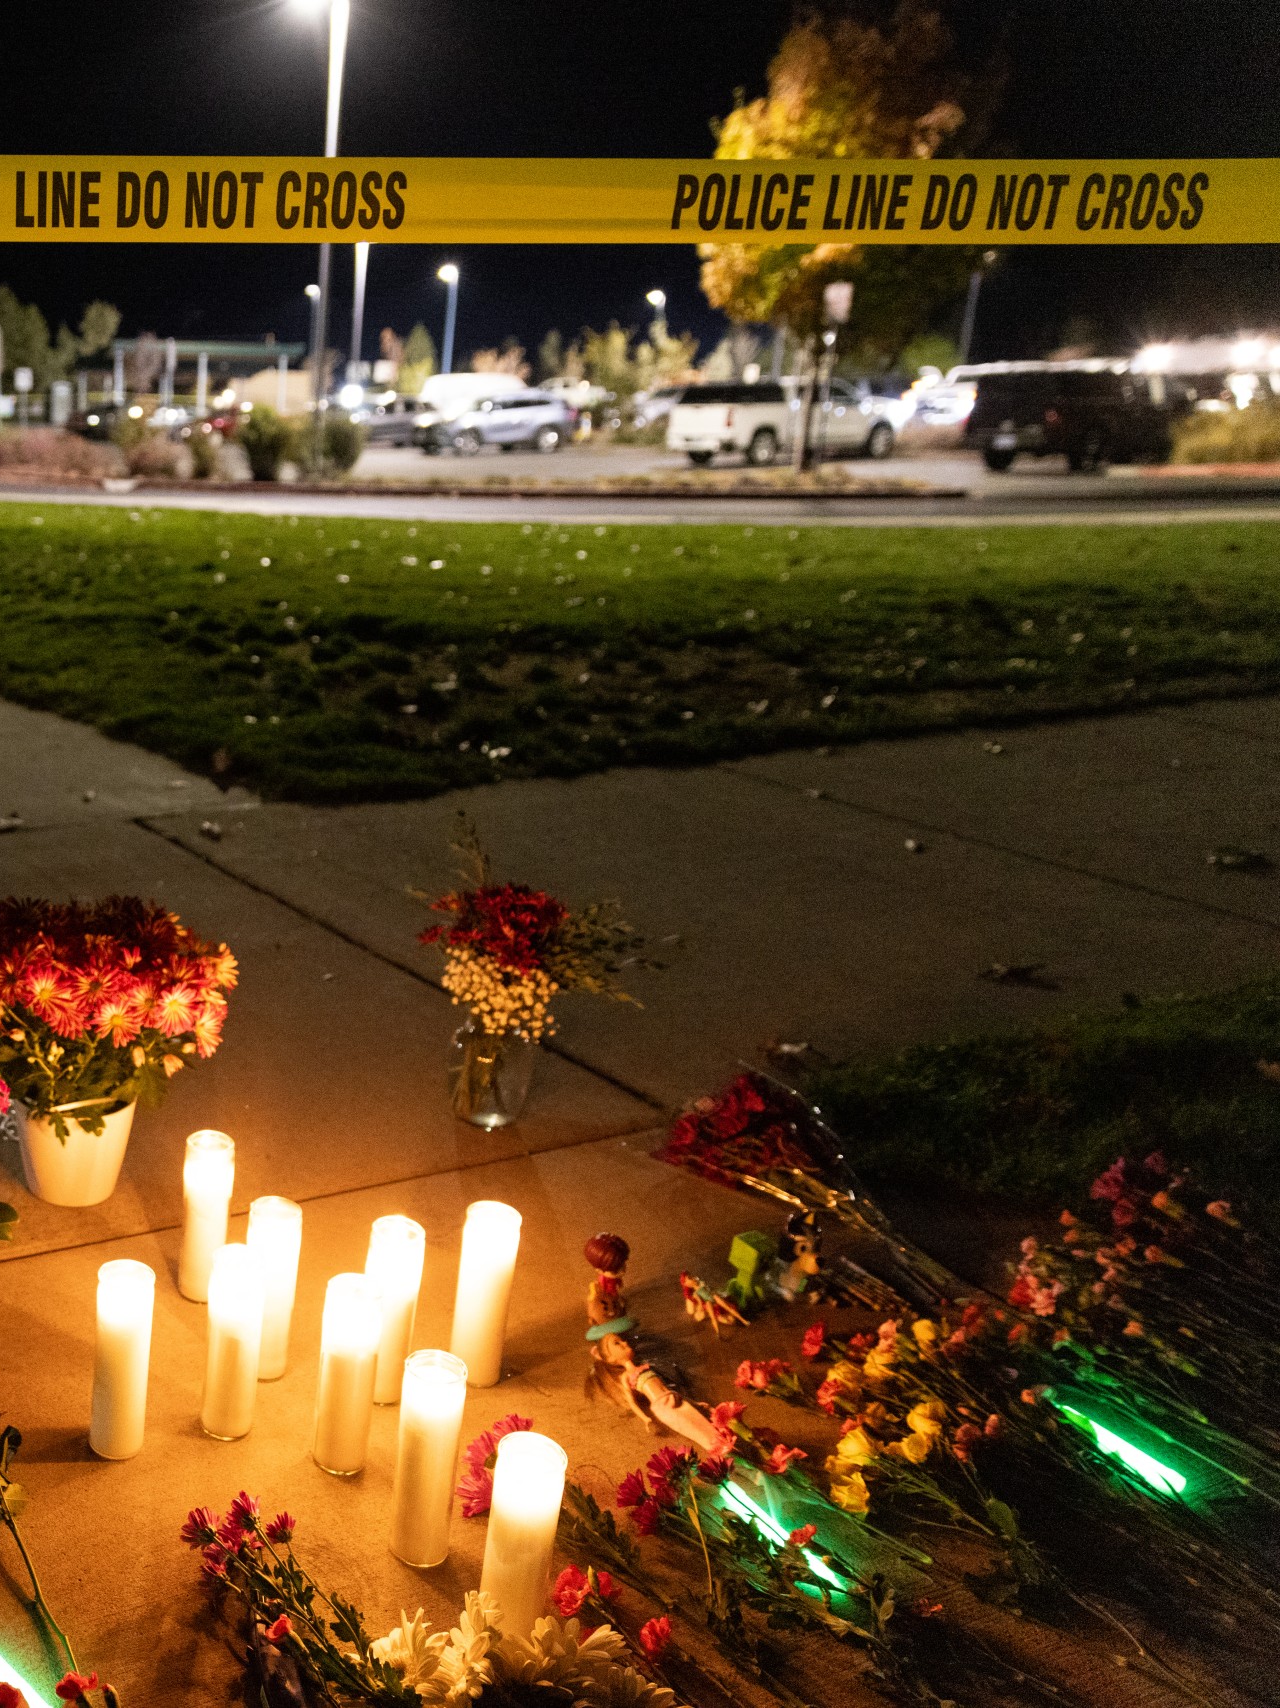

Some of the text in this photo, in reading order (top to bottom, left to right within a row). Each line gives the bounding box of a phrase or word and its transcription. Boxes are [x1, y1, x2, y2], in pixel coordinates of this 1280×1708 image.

[16, 171, 101, 228] LINE
[117, 170, 169, 229] DO
[185, 172, 263, 230] NOT
[277, 171, 407, 230] CROSS
[671, 172, 1209, 231] POLICE LINE DO NOT CROSS
